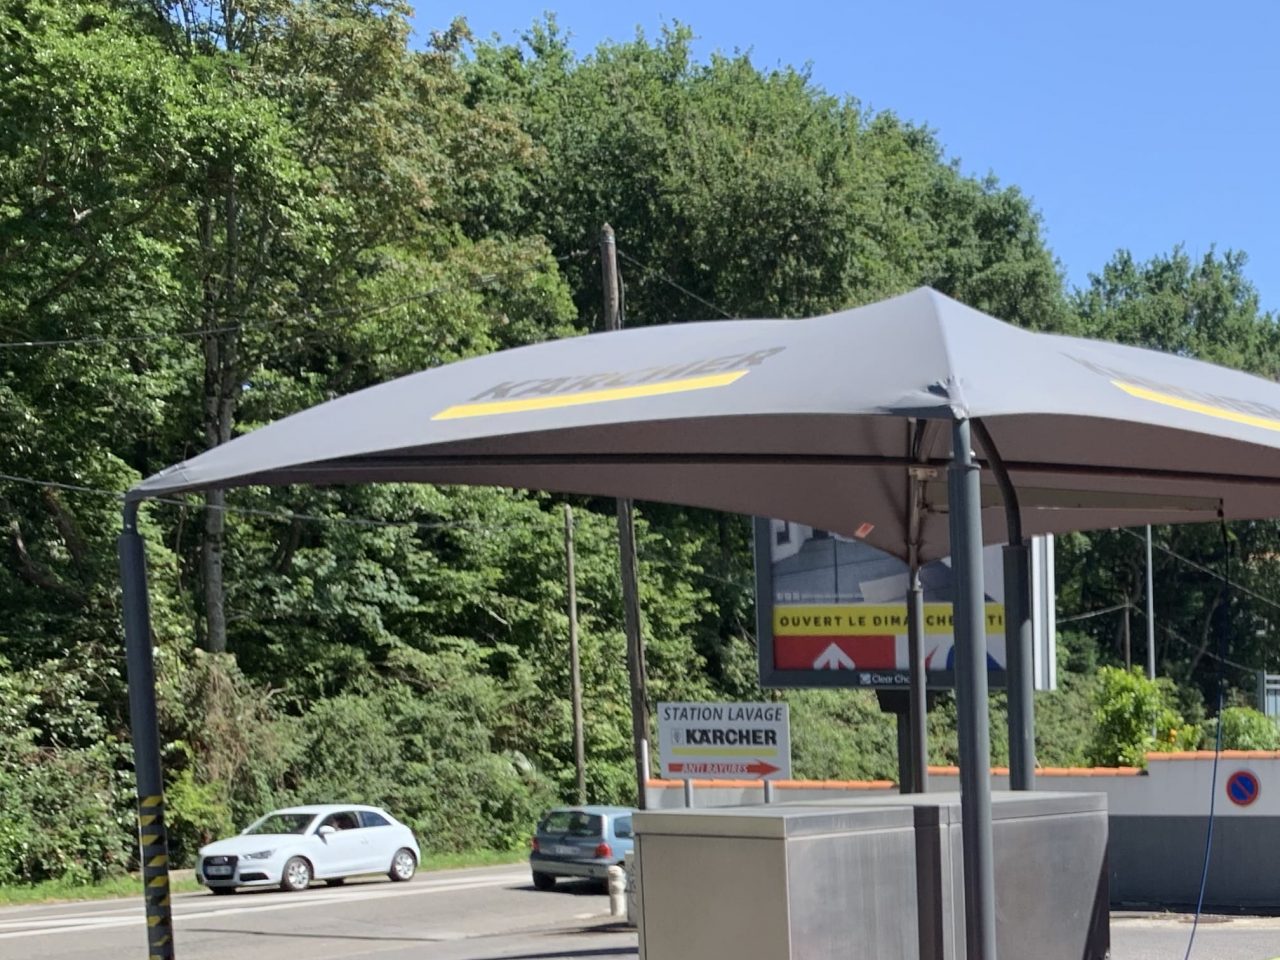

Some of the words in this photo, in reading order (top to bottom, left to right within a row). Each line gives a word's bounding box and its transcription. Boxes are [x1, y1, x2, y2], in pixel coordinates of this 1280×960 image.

[779, 615, 842, 628] OUVERT
[848, 615, 867, 628] LE
[872, 673, 893, 684] Clear
[663, 706, 723, 721] STATION
[727, 707, 782, 722] LAVAGE
[686, 728, 777, 745] KÄRCHER
[684, 763, 704, 774] ANTI
